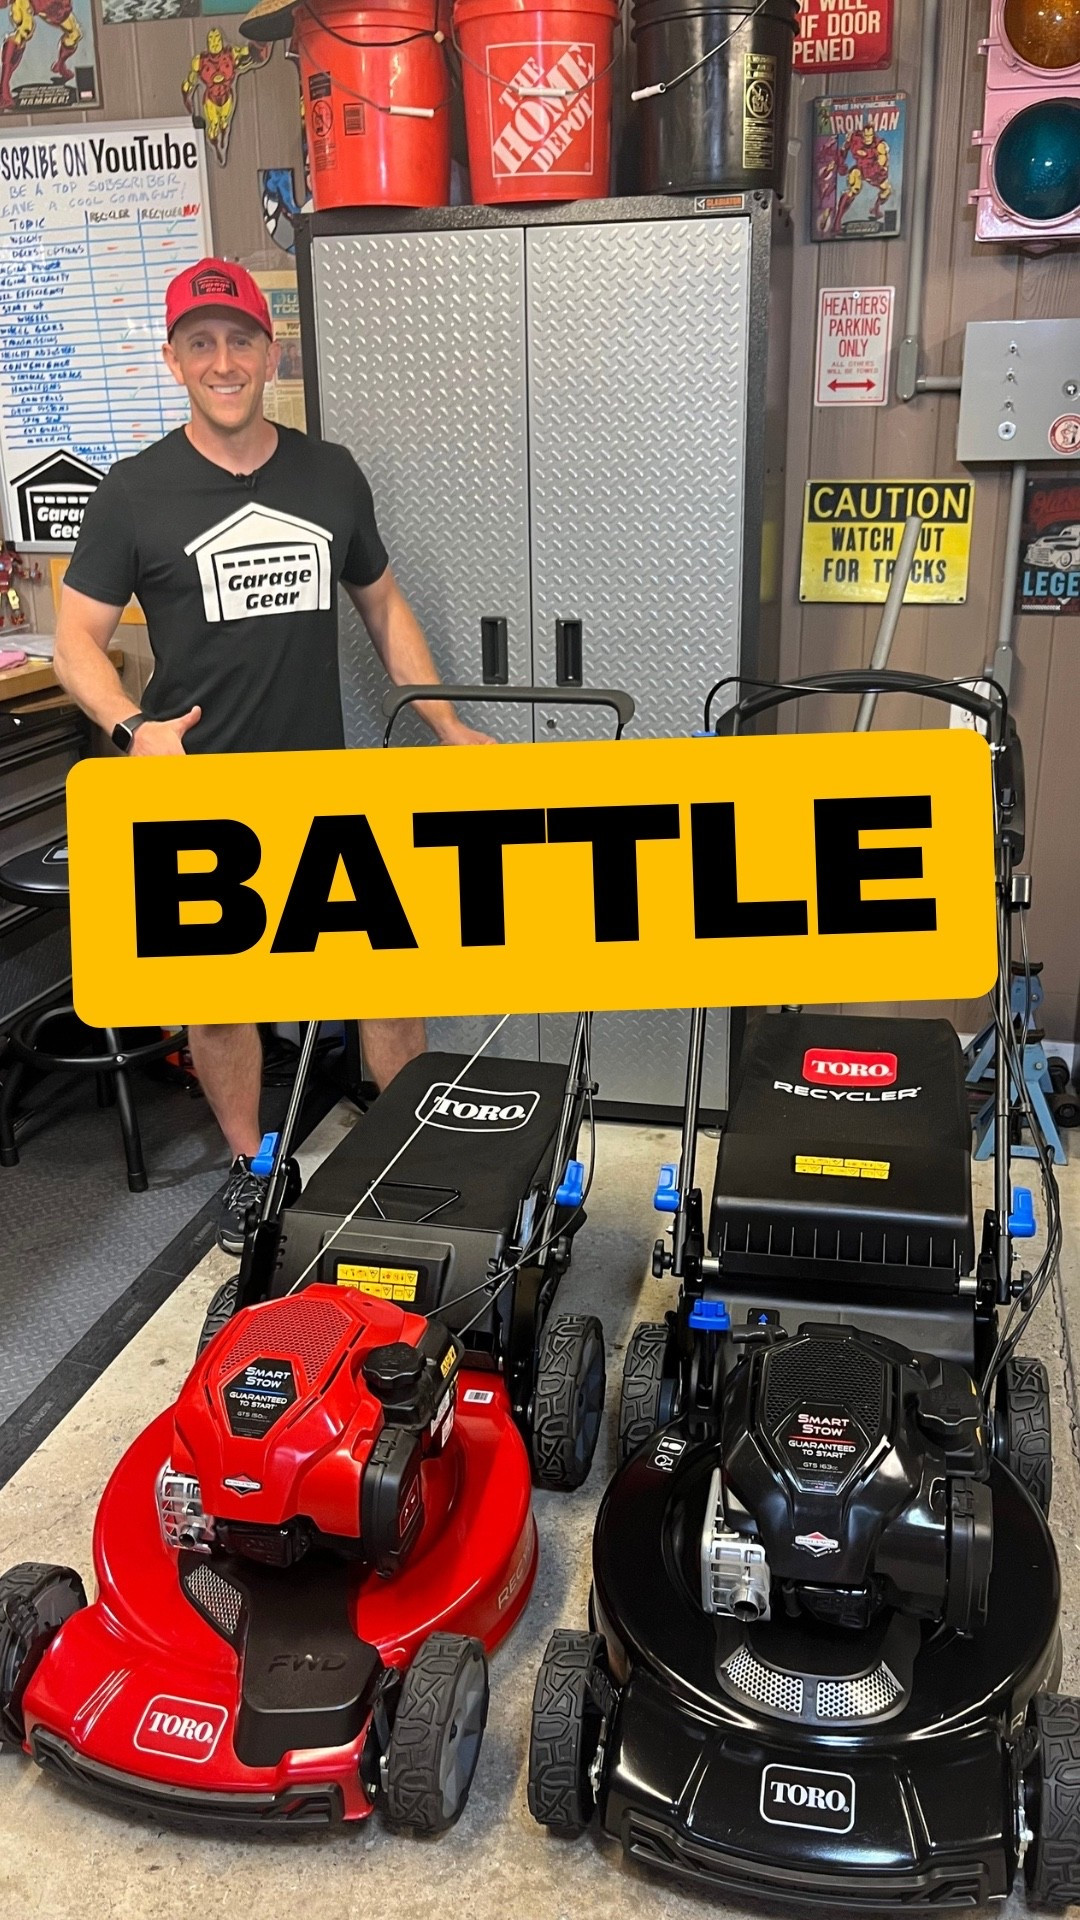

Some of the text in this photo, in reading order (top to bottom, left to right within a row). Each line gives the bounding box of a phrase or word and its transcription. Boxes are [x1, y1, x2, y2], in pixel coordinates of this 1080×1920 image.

[801, 10, 880, 38] IF DOOR
[792, 37, 855, 64] PENED
[499, 56, 545, 110] THE
[492, 44, 594, 174] HOME
[531, 94, 593, 173] DEPOT
[830, 111, 900, 134] IRON MAN
[1, 133, 198, 181] SCRIBE ON YouTube
[10, 184, 27, 199] BE
[52, 181, 77, 193] TOP
[69, 197, 103, 208] COOL
[9, 217, 45, 231] TOPIC
[824, 296, 888, 316] HEATHER'S
[829, 318, 881, 337] PARKING
[839, 339, 868, 358] ONLY
[813, 487, 966, 519] CAUTION
[832, 527, 944, 552] WATCH UT
[228, 568, 312, 592] Garage
[823, 558, 946, 583] FOR TRCKS
[1023, 571, 1080, 597] LEGE
[245, 591, 300, 610] Gear
[812, 1059, 893, 1077] TORO
[773, 1080, 922, 1102] RECYCLER
[434, 1096, 526, 1121] TORO
[245, 1367, 291, 1380] SMART
[245, 1376, 282, 1389] STOW
[229, 1391, 288, 1405] GUARANTEED
[798, 1413, 850, 1427] SMART
[802, 1424, 843, 1437] STOW
[788, 1440, 856, 1453] GUARANTEED
[269, 1653, 347, 1674] FWD
[148, 1711, 214, 1744] TORO
[770, 1781, 849, 1812] TORO
